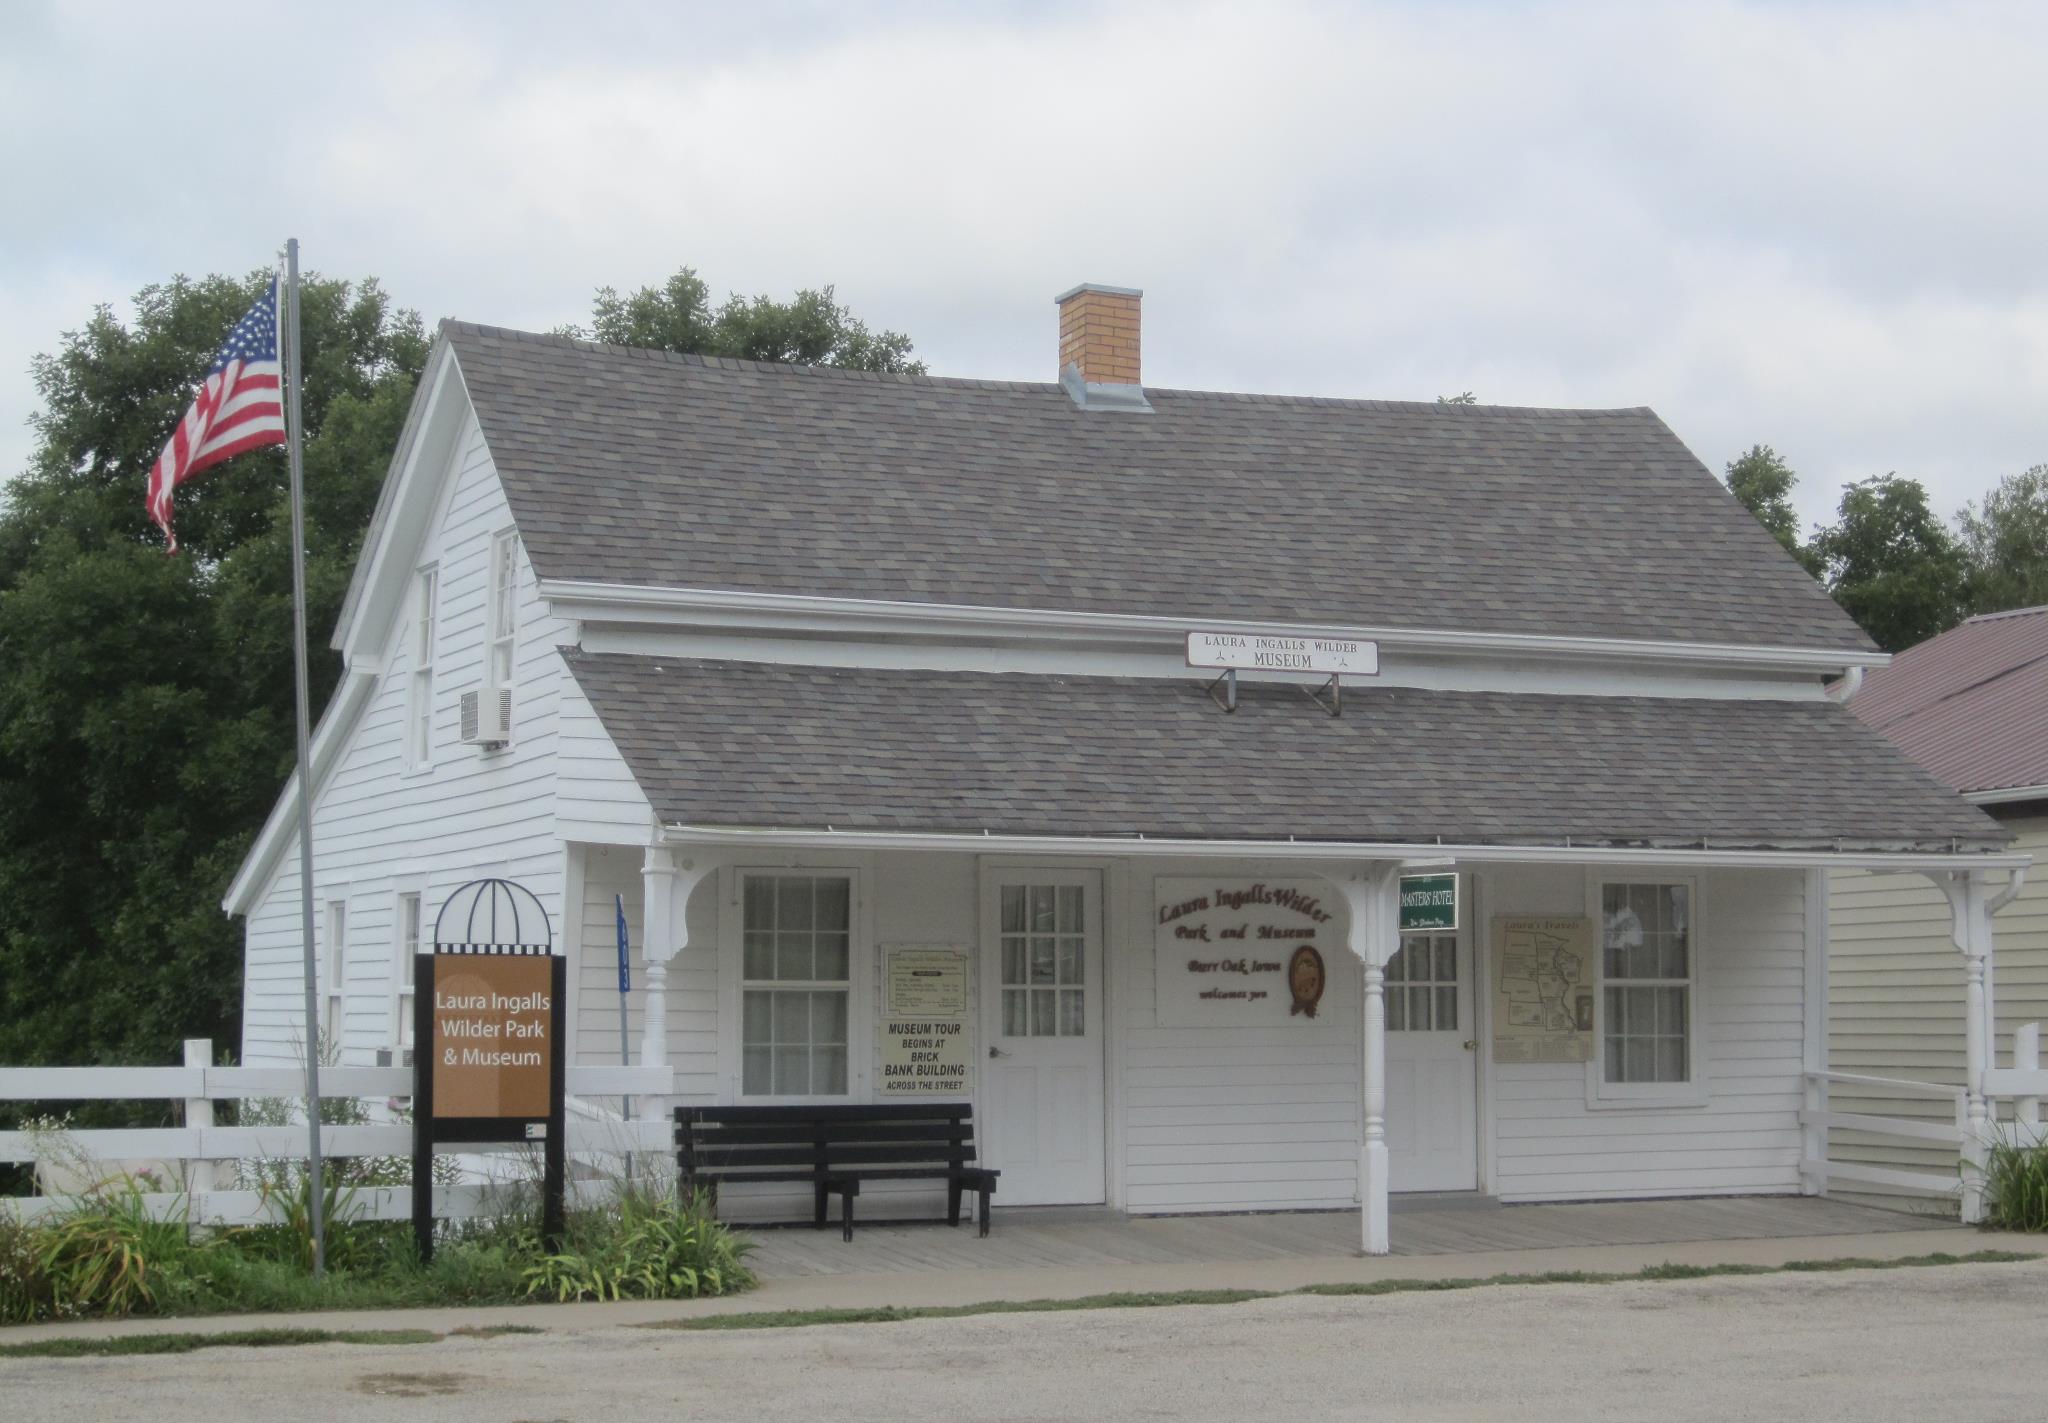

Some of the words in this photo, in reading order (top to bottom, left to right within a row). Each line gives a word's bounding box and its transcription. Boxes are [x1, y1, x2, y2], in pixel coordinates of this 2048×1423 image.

[1204, 635, 1247, 648] LAURA
[1255, 638, 1306, 651] INGALLS
[1314, 642, 1358, 653] WILDER
[1254, 652, 1313, 668] MUSEUM
[1158, 896, 1209, 925] Laura
[1214, 884, 1273, 911] Ingalls
[1273, 888, 1332, 923] Wilder
[1432, 890, 1455, 906] HOTEL
[1174, 923, 1212, 943] Park
[1219, 923, 1249, 939] and
[1256, 925, 1317, 939] Museum
[1199, 987, 1247, 1000] welcomes
[1248, 990, 1268, 1002] you
[436, 992, 487, 1010] Laura
[491, 992, 551, 1014] Ingalls
[441, 1020, 500, 1038] Wilder
[505, 1020, 545, 1038] Park
[888, 1023, 932, 1035] MUSEUM
[934, 1023, 961, 1035] TOUR
[902, 1039, 933, 1049] BEGINS
[934, 1039, 946, 1049] AT
[443, 1048, 457, 1066] &
[462, 1048, 541, 1066] Museum
[911, 1052, 939, 1062] BRICK
[885, 1065, 914, 1077] BANK
[916, 1065, 965, 1077] BUILDING
[886, 1081, 917, 1090] ACROSS
[918, 1081, 933, 1090] THE
[935, 1081, 964, 1090] STREET
